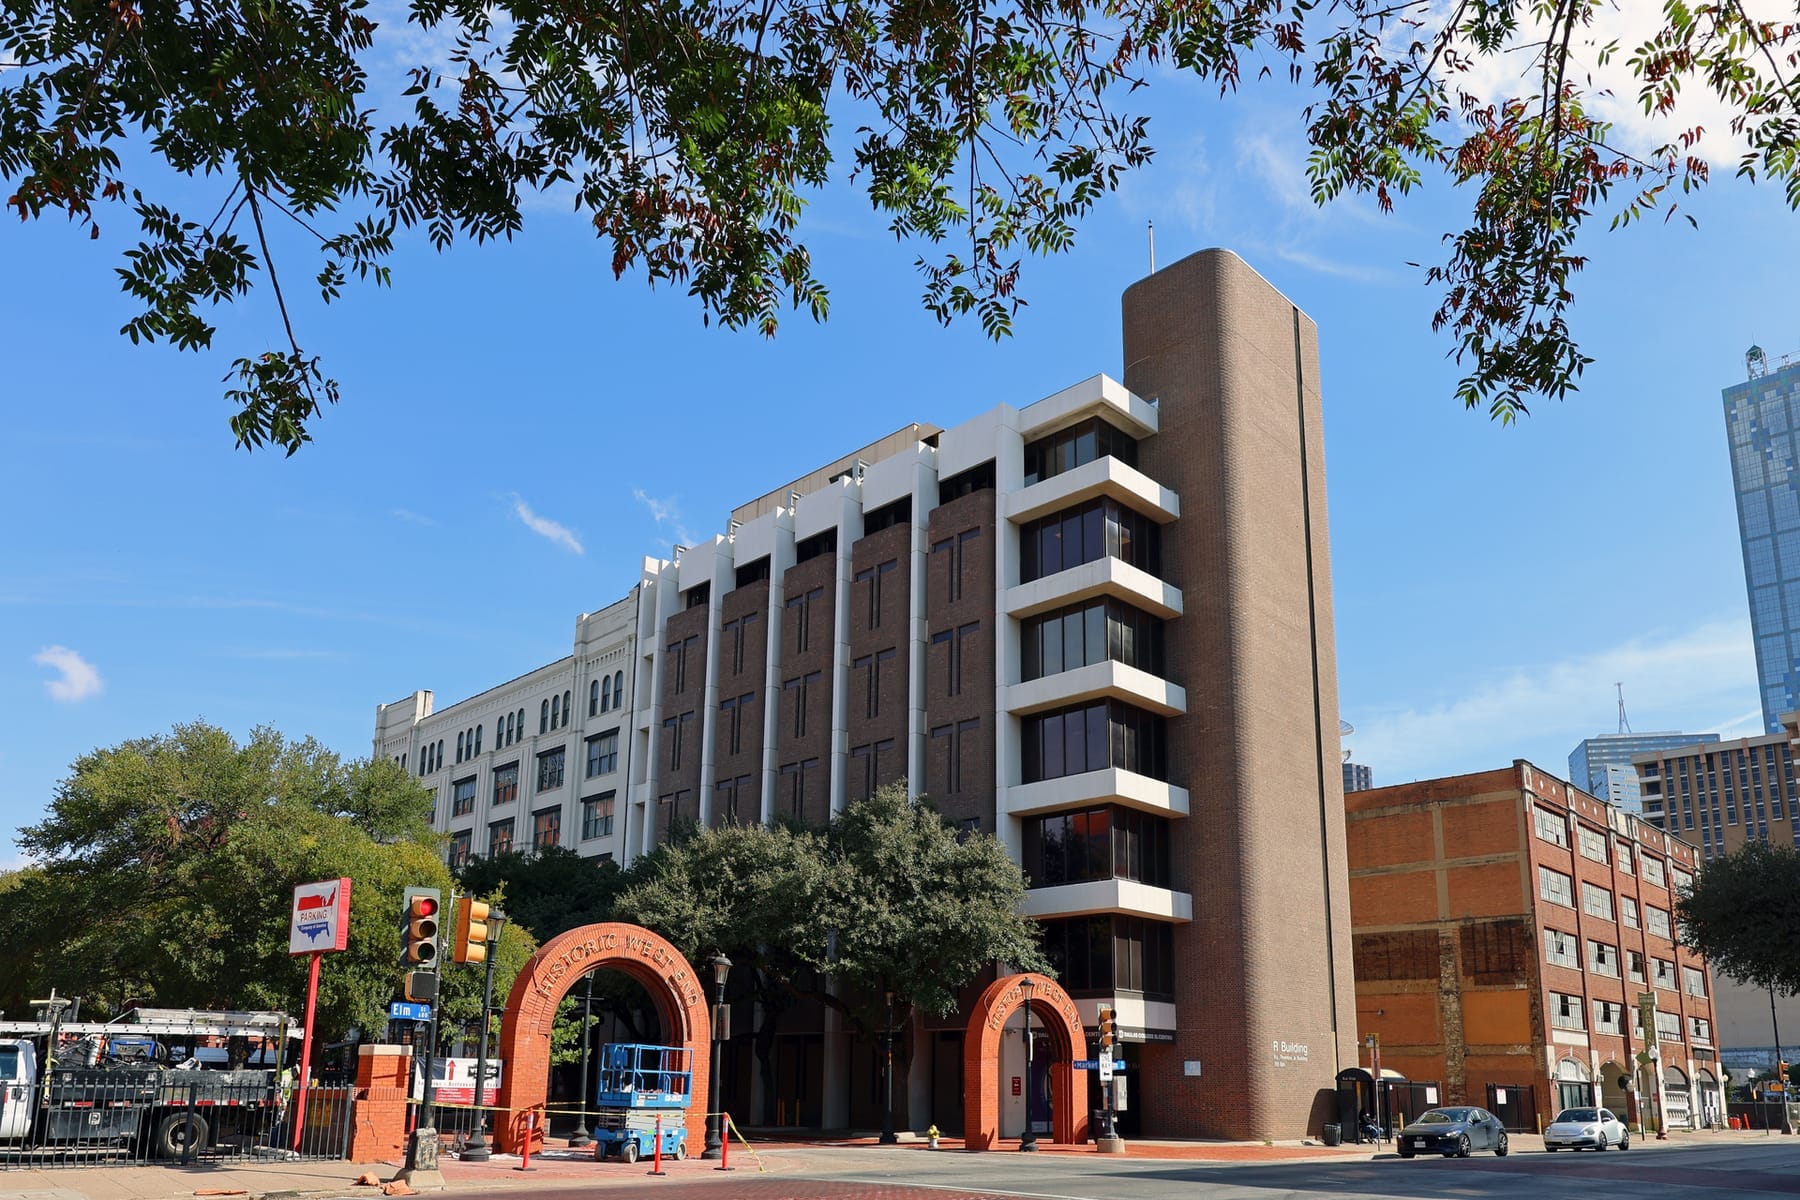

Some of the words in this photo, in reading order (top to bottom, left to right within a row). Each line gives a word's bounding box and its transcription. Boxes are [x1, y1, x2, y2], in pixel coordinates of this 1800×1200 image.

[300, 910, 328, 921] PARKING
[538, 934, 618, 998] HISTORIC
[626, 934, 673, 969] WEST
[673, 970, 699, 1008] END
[393, 1003, 411, 1017] Elm
[1273, 1041, 1279, 1051] R
[1281, 1041, 1308, 1057] Building
